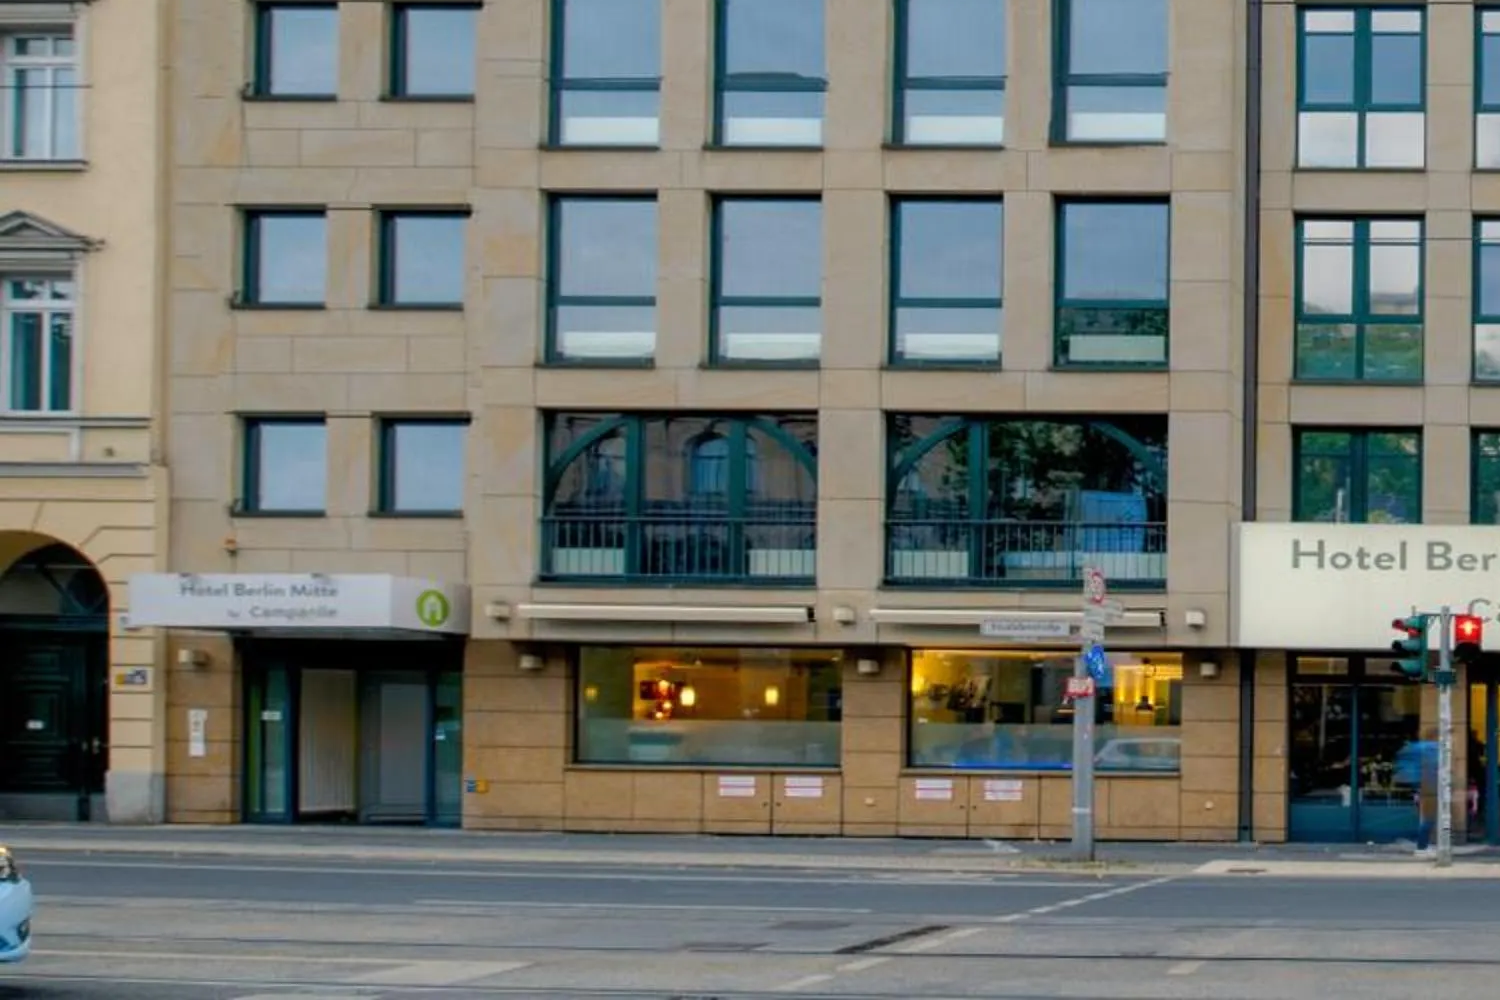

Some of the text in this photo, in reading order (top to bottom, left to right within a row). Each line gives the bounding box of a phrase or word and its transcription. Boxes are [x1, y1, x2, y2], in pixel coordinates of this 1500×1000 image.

[1291, 539, 1408, 572] Hotel
[179, 580, 339, 598] Hotel Berlin Mitte
